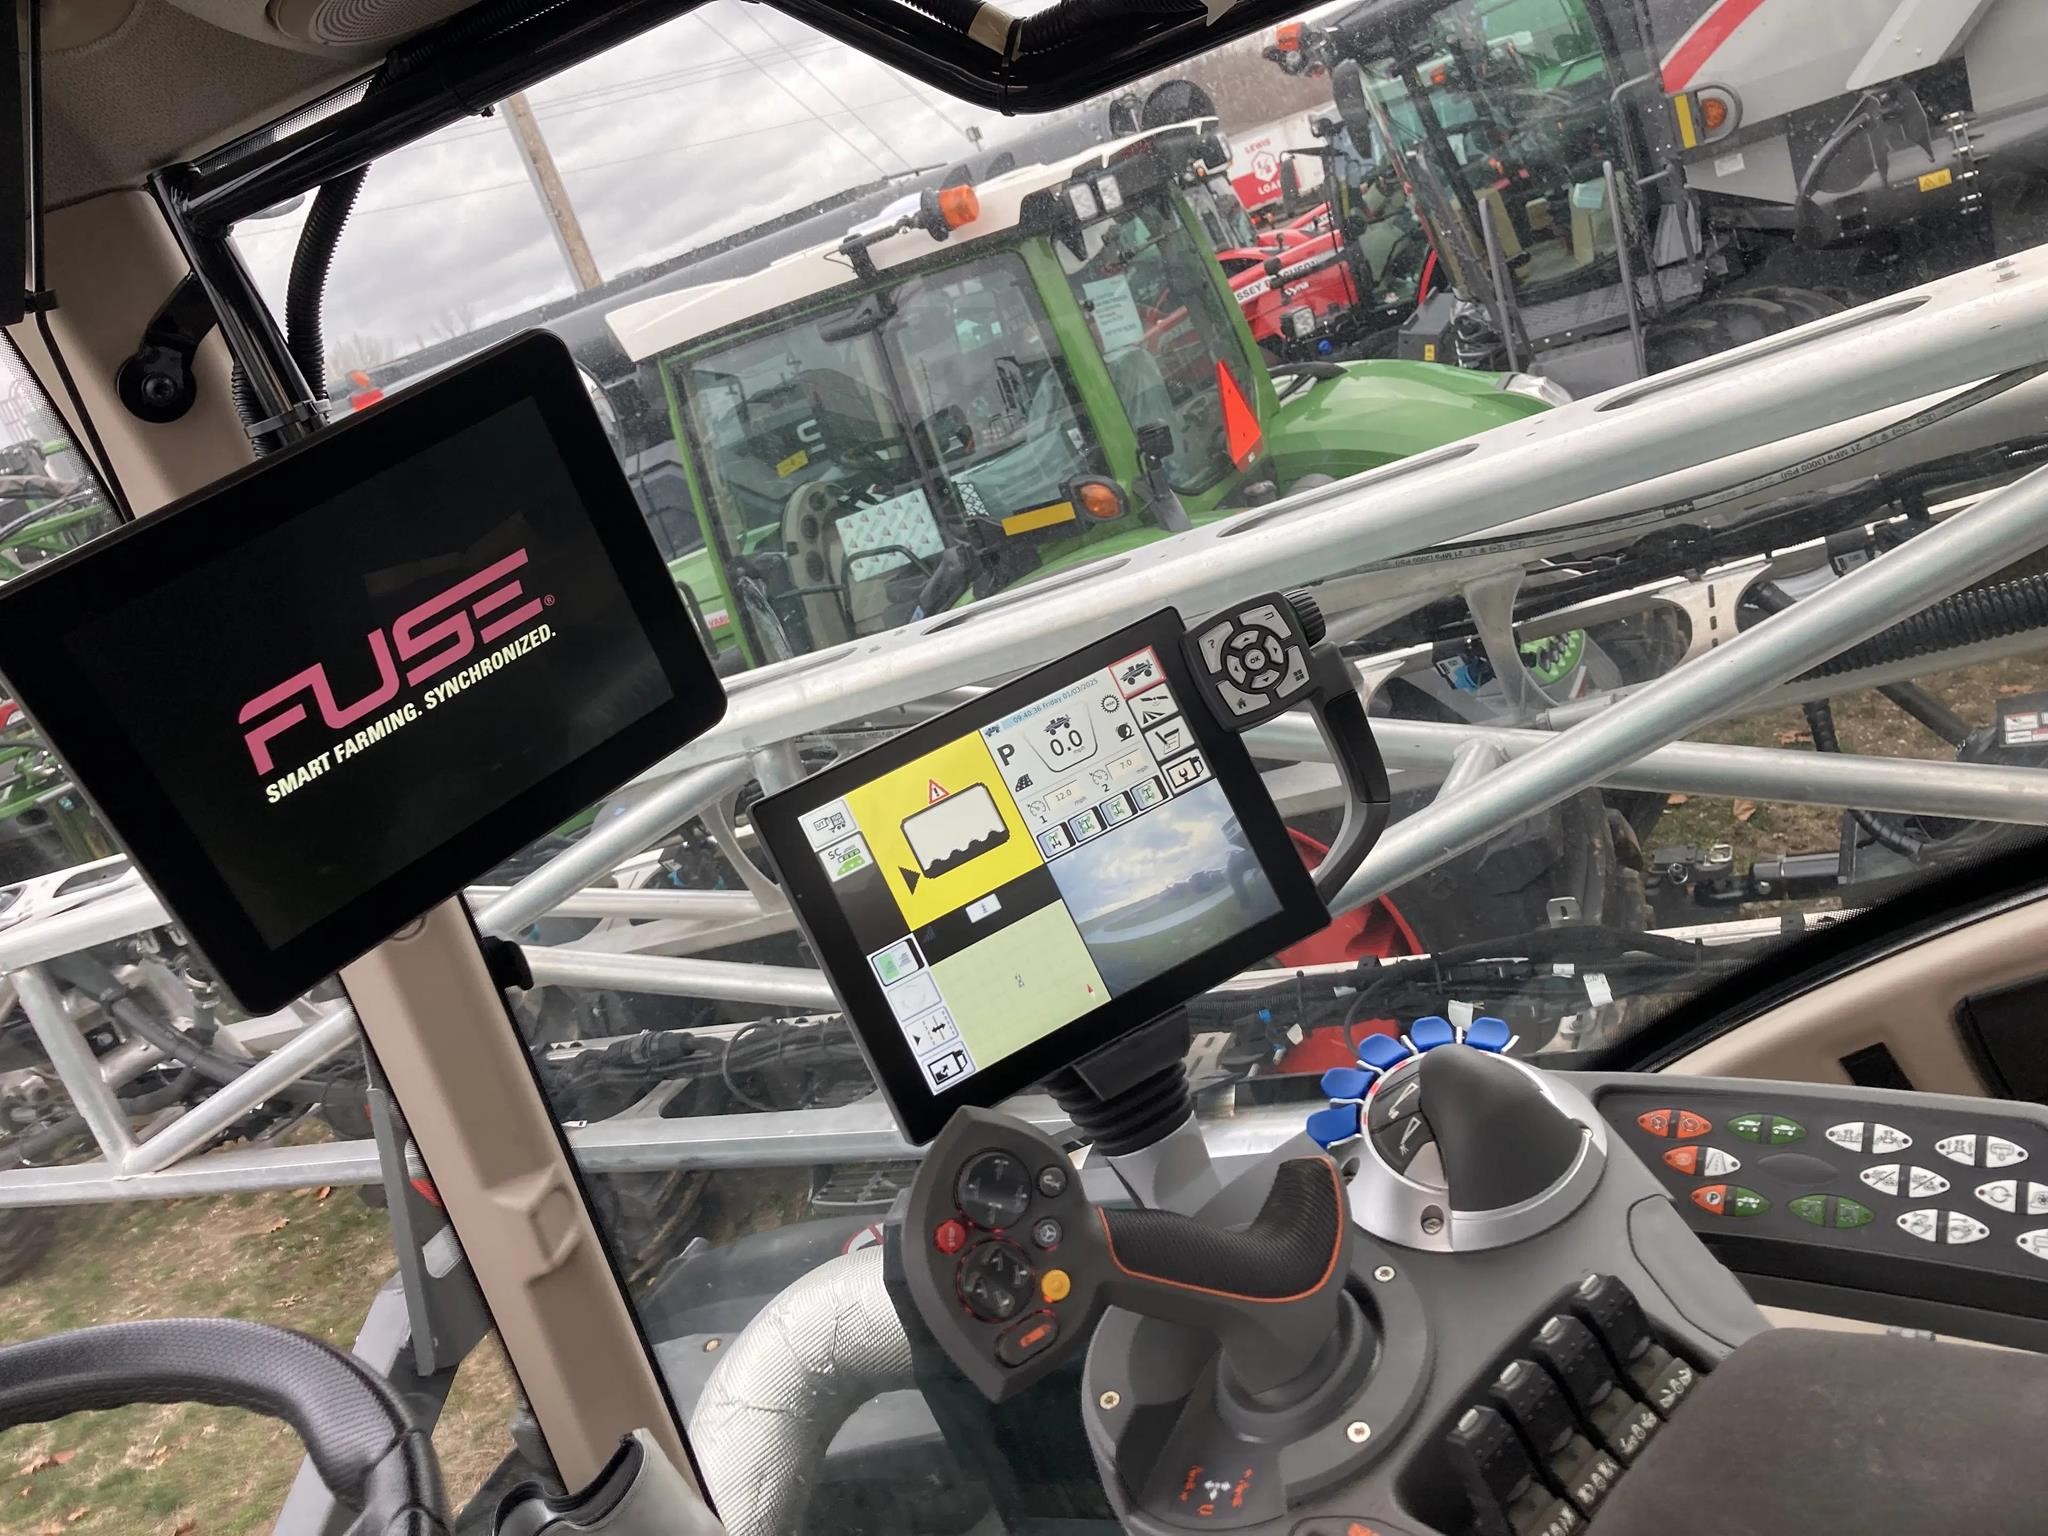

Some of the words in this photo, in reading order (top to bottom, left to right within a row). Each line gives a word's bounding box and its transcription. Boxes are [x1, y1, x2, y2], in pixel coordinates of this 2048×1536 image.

[1258, 180, 1281, 195] LOA
[1236, 284, 1262, 300] SSEY
[238, 548, 544, 776] FUSE
[1250, 655, 1261, 664] OK
[1042, 695, 1062, 709] Friday
[265, 752, 330, 804] SMART
[333, 702, 423, 764] FARMING.
[424, 623, 557, 710] SYNCHRONIZED.
[1050, 730, 1082, 756] 0.0
[997, 744, 1015, 766] P
[1120, 759, 1133, 769] 7.0
[1102, 783, 1110, 792] 2
[1055, 789, 1072, 802] 12.0
[1040, 815, 1047, 824] 1
[828, 848, 842, 860] SC
